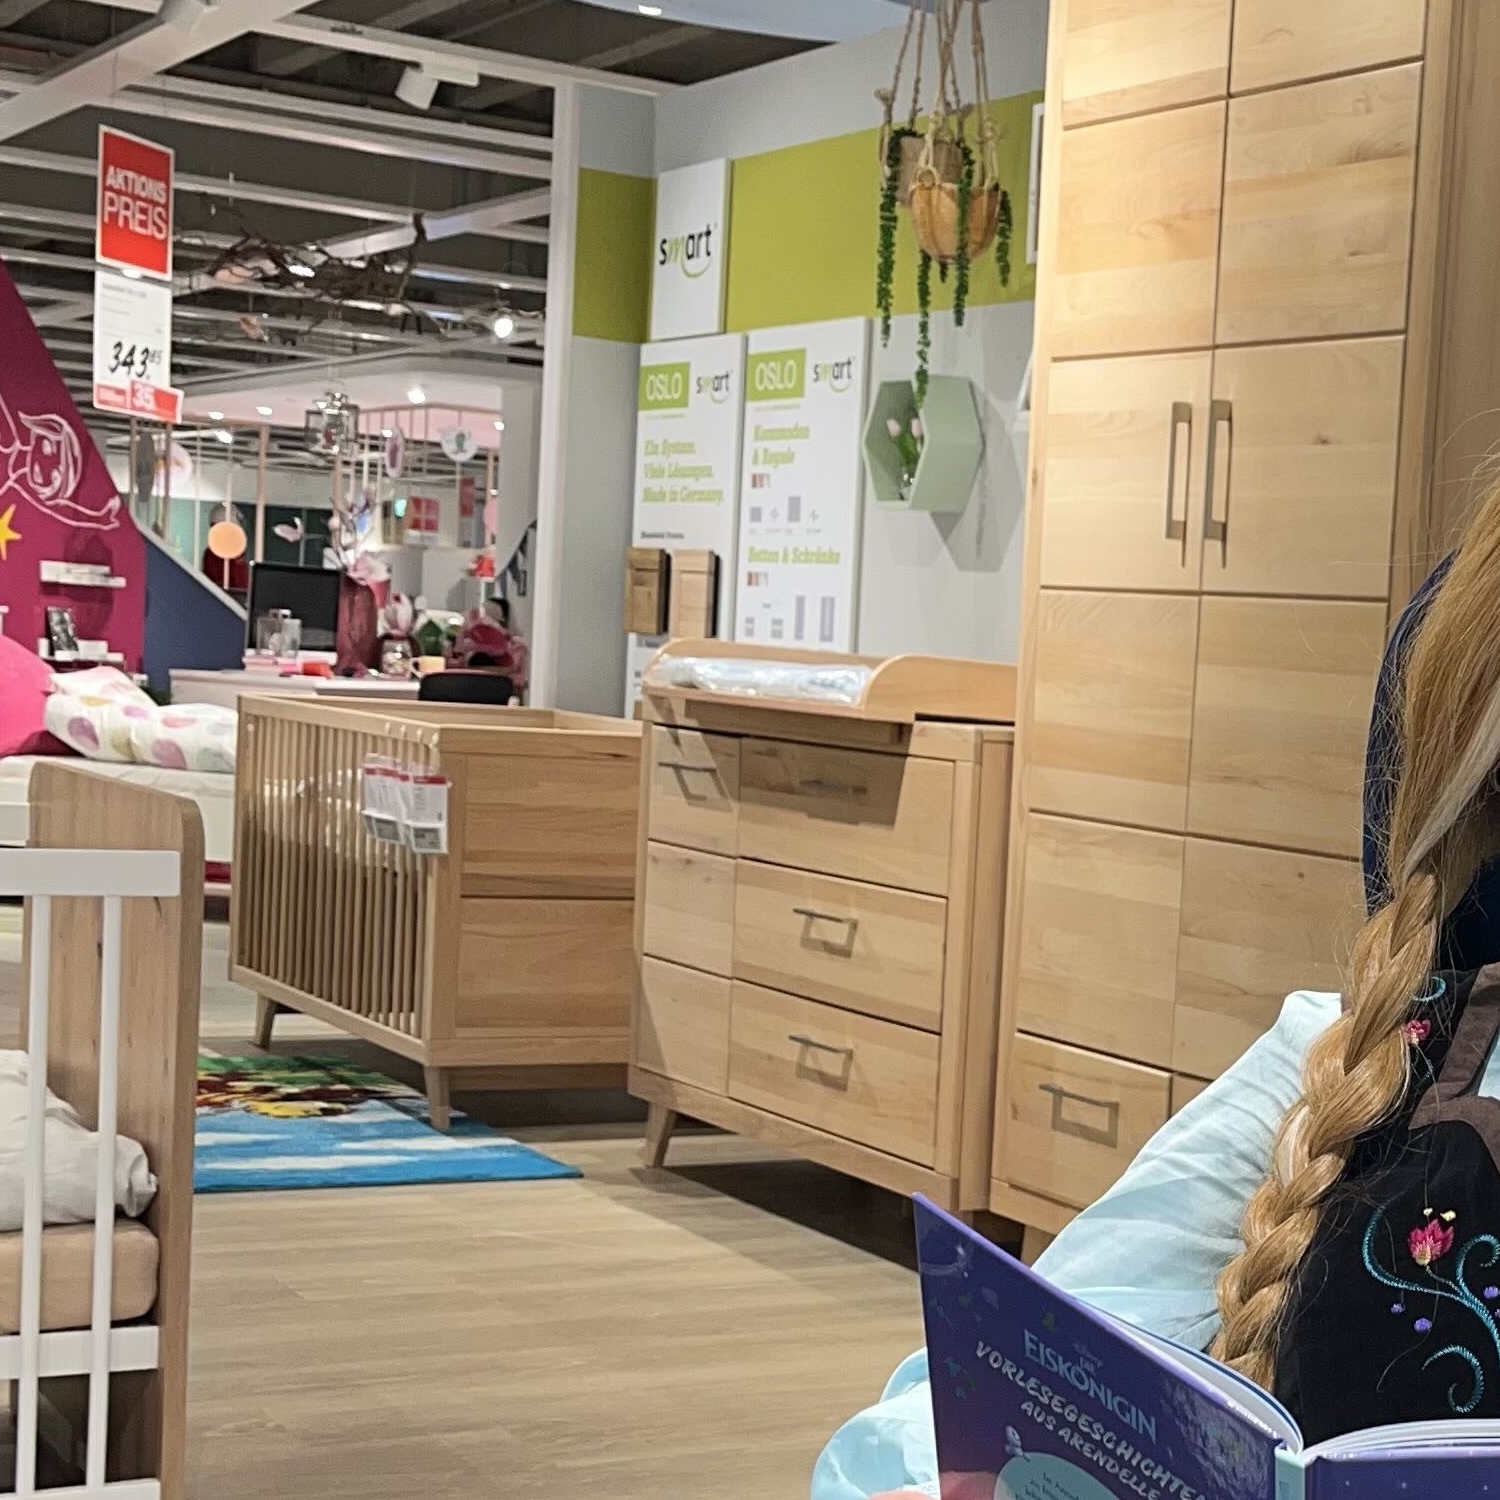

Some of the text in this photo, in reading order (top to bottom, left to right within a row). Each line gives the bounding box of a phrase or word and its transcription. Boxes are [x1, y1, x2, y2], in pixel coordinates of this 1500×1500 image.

[106, 164, 167, 204] AKTIONS
[104, 191, 167, 241] PREIS
[659, 223, 711, 270] smart
[646, 371, 682, 401] OSLO
[696, 370, 729, 399] smart
[755, 359, 797, 391] OSLO
[813, 358, 852, 387] smart
[1023, 1328, 1157, 1445] EISKÖNIGIN
[1020, 1400, 1057, 1431] AUS
